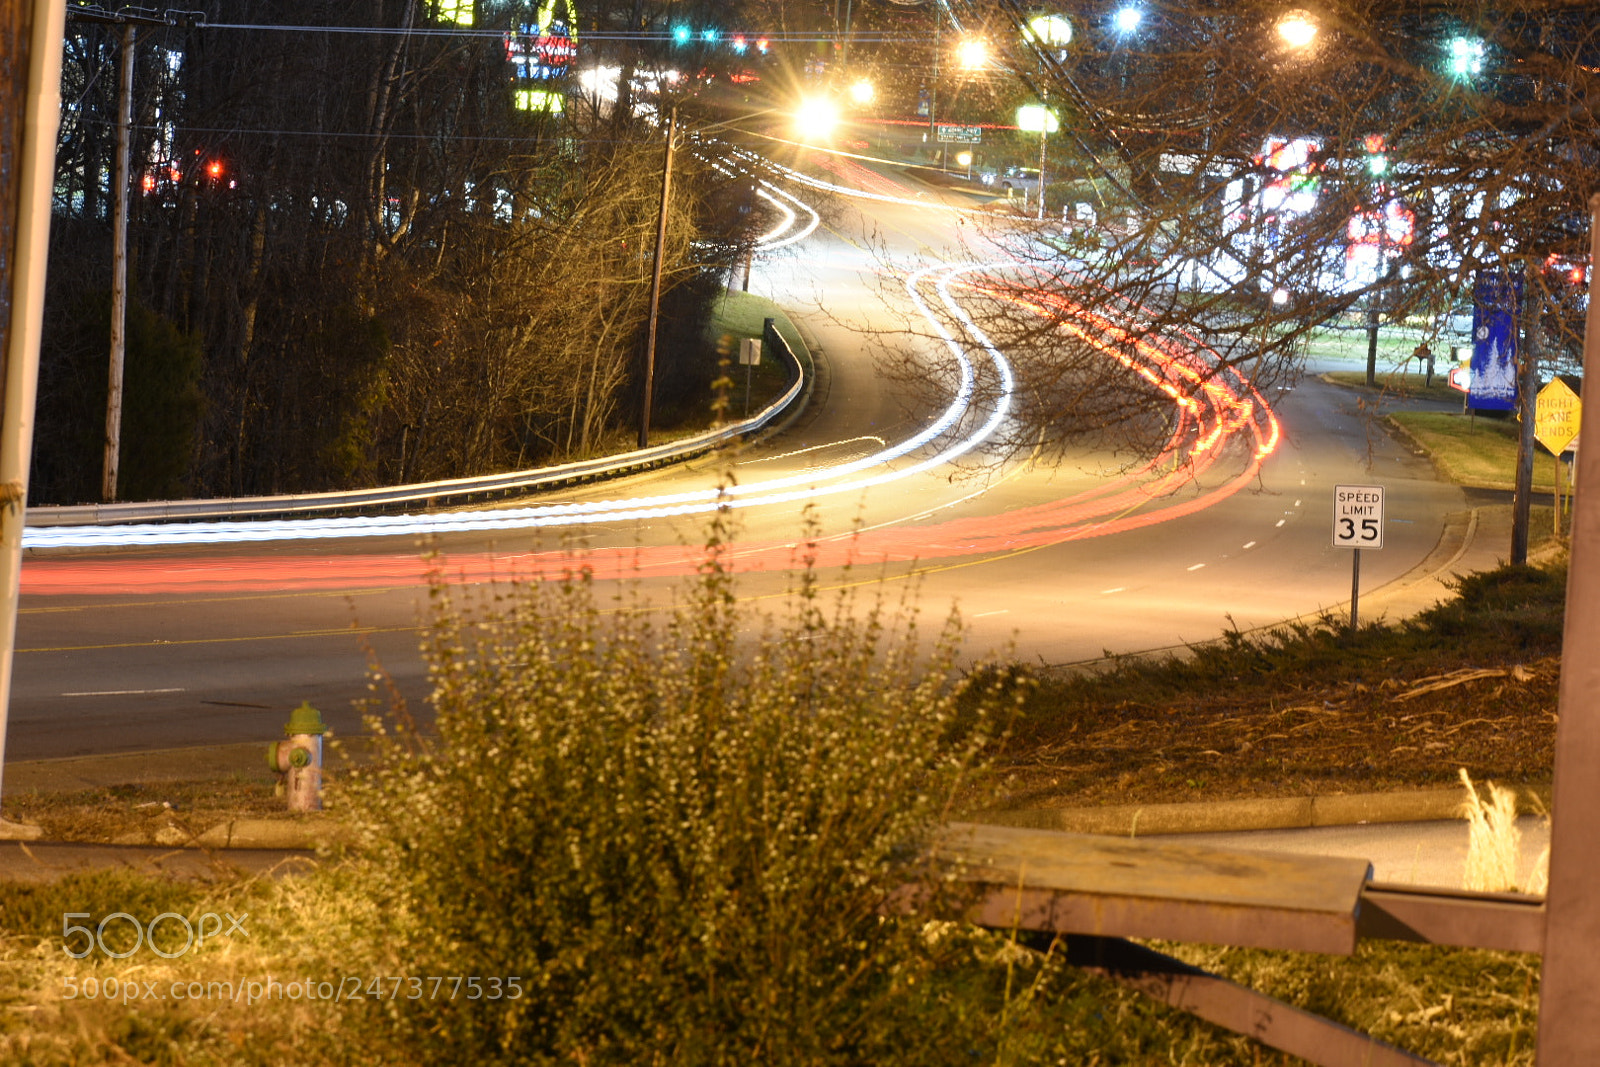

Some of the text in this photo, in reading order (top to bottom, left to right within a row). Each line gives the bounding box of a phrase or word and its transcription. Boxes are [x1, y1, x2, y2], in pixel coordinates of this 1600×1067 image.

[1538, 399, 1573, 409] RIGHT
[1540, 411, 1572, 422] LANE
[1541, 426, 1573, 437] ENDS
[1339, 492, 1380, 503] SPEED
[1342, 505, 1374, 515] LIMIT
[1338, 518, 1379, 541] 35
